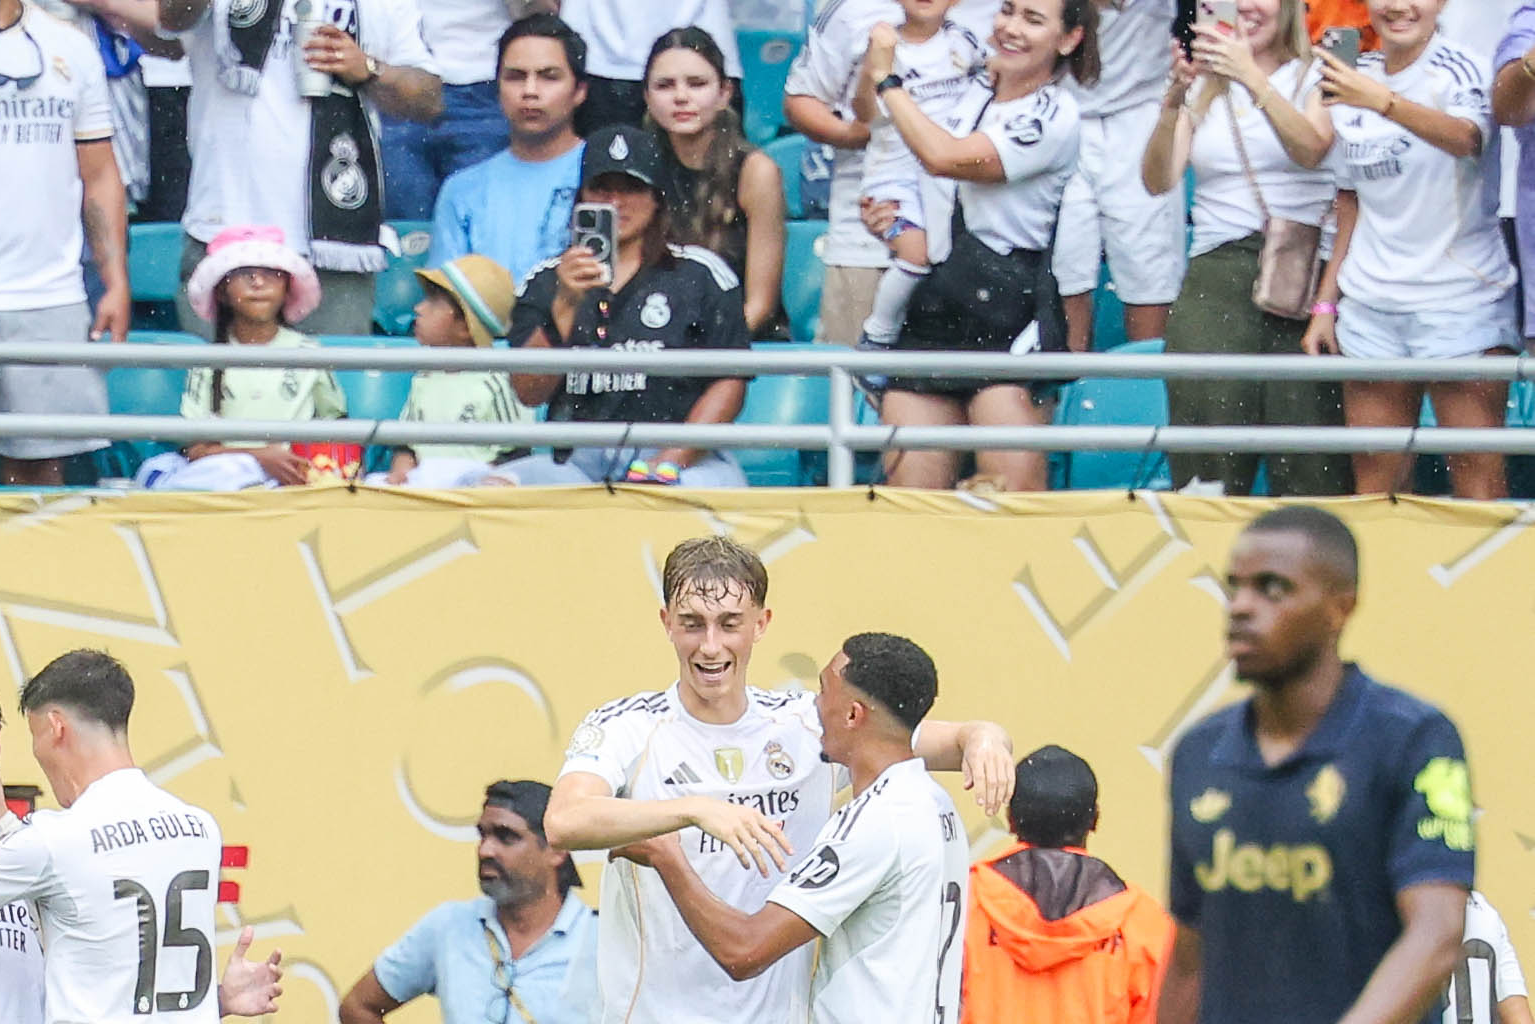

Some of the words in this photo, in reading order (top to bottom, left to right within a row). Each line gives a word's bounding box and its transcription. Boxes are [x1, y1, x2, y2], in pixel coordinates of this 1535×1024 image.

[90, 820, 149, 854] ARDA
[148, 810, 209, 841] GÜLER
[1195, 829, 1331, 901] Jeep
[113, 869, 213, 1015] 15
